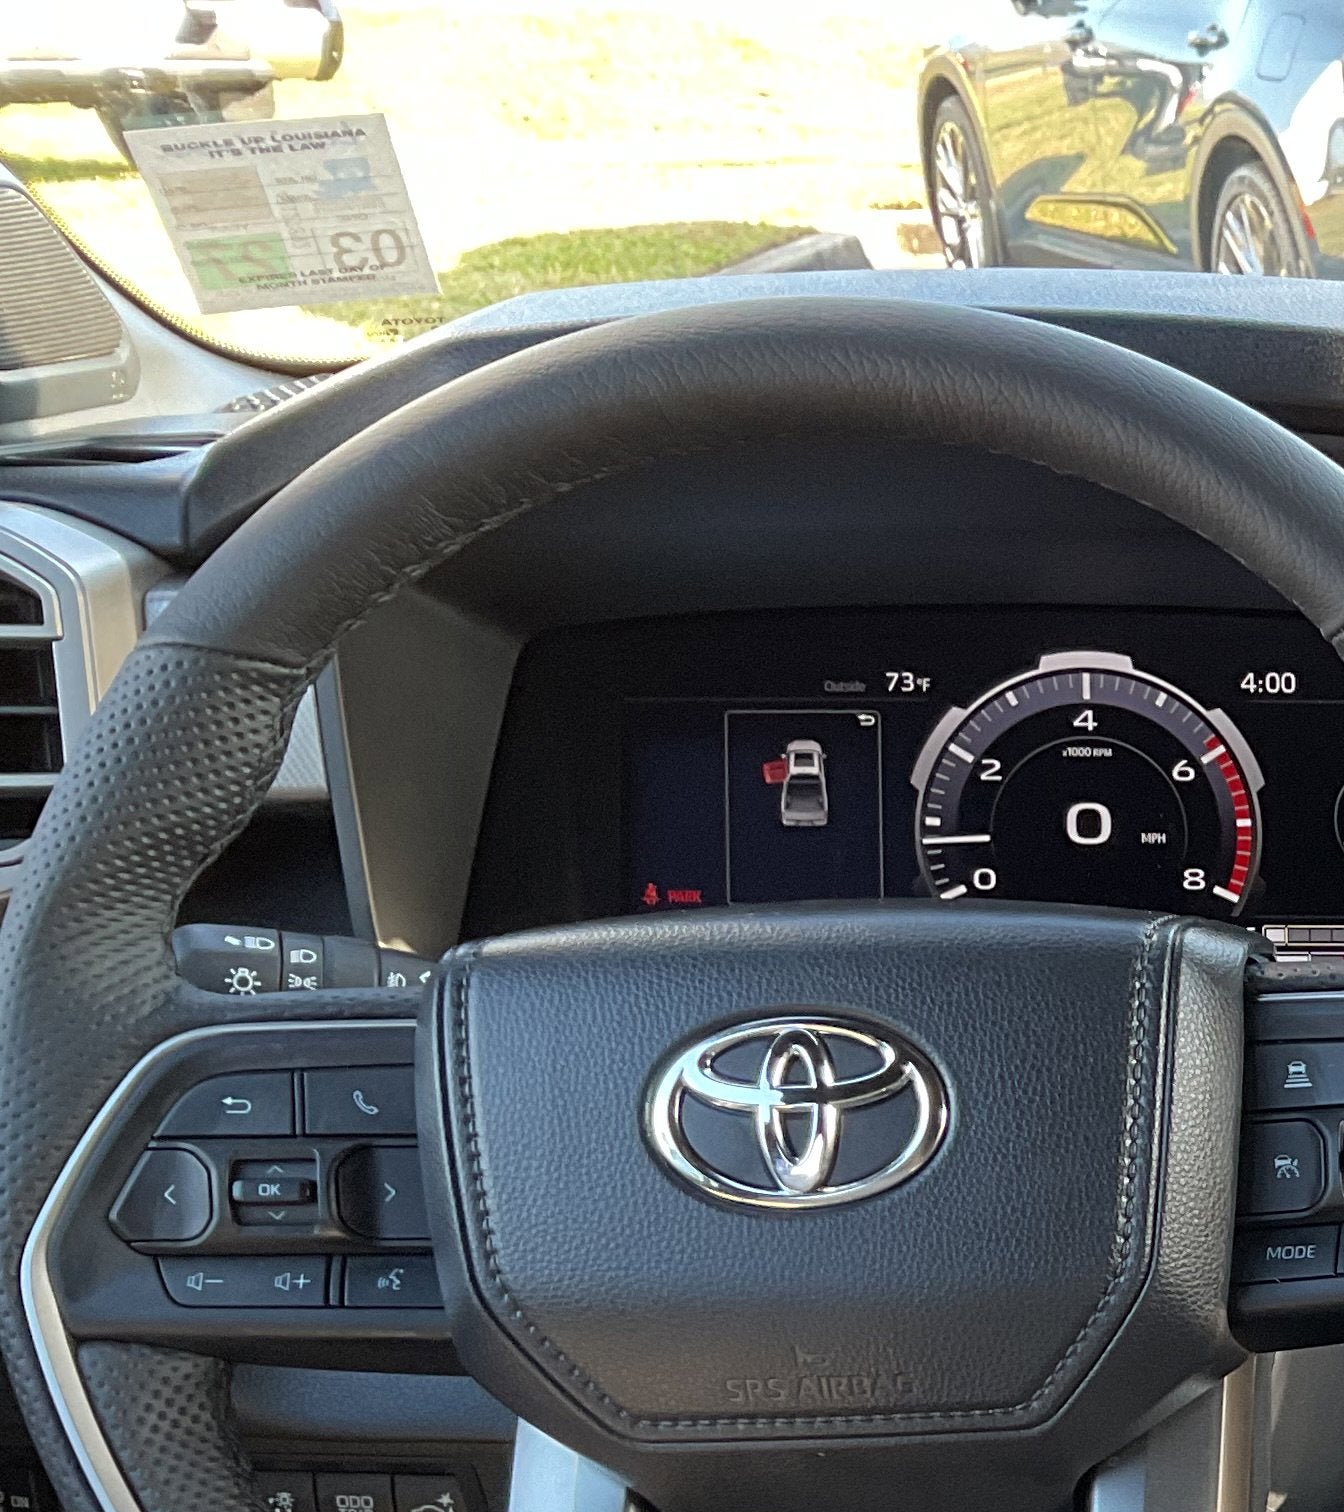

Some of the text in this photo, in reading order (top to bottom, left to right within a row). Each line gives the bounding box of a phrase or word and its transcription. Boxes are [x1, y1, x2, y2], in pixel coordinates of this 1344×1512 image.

[269, 127, 367, 143] LOUISIANA
[288, 140, 327, 152] LAW
[1240, 672, 1297, 694] 4:00
[1073, 709, 1098, 731] 4
[1092, 748, 1113, 758] RPM
[980, 759, 1003, 781] 2
[1171, 759, 1195, 782] 6
[1066, 802, 1112, 845] 0
[1141, 832, 1167, 845] MPH
[973, 868, 997, 890] 0
[1183, 868, 1206, 890] 8
[257, 1182, 281, 1198] OK
[1265, 1243, 1317, 1262] MODE
[725, 1377, 786, 1402] SRS
[336, 1495, 374, 1508] ODO
